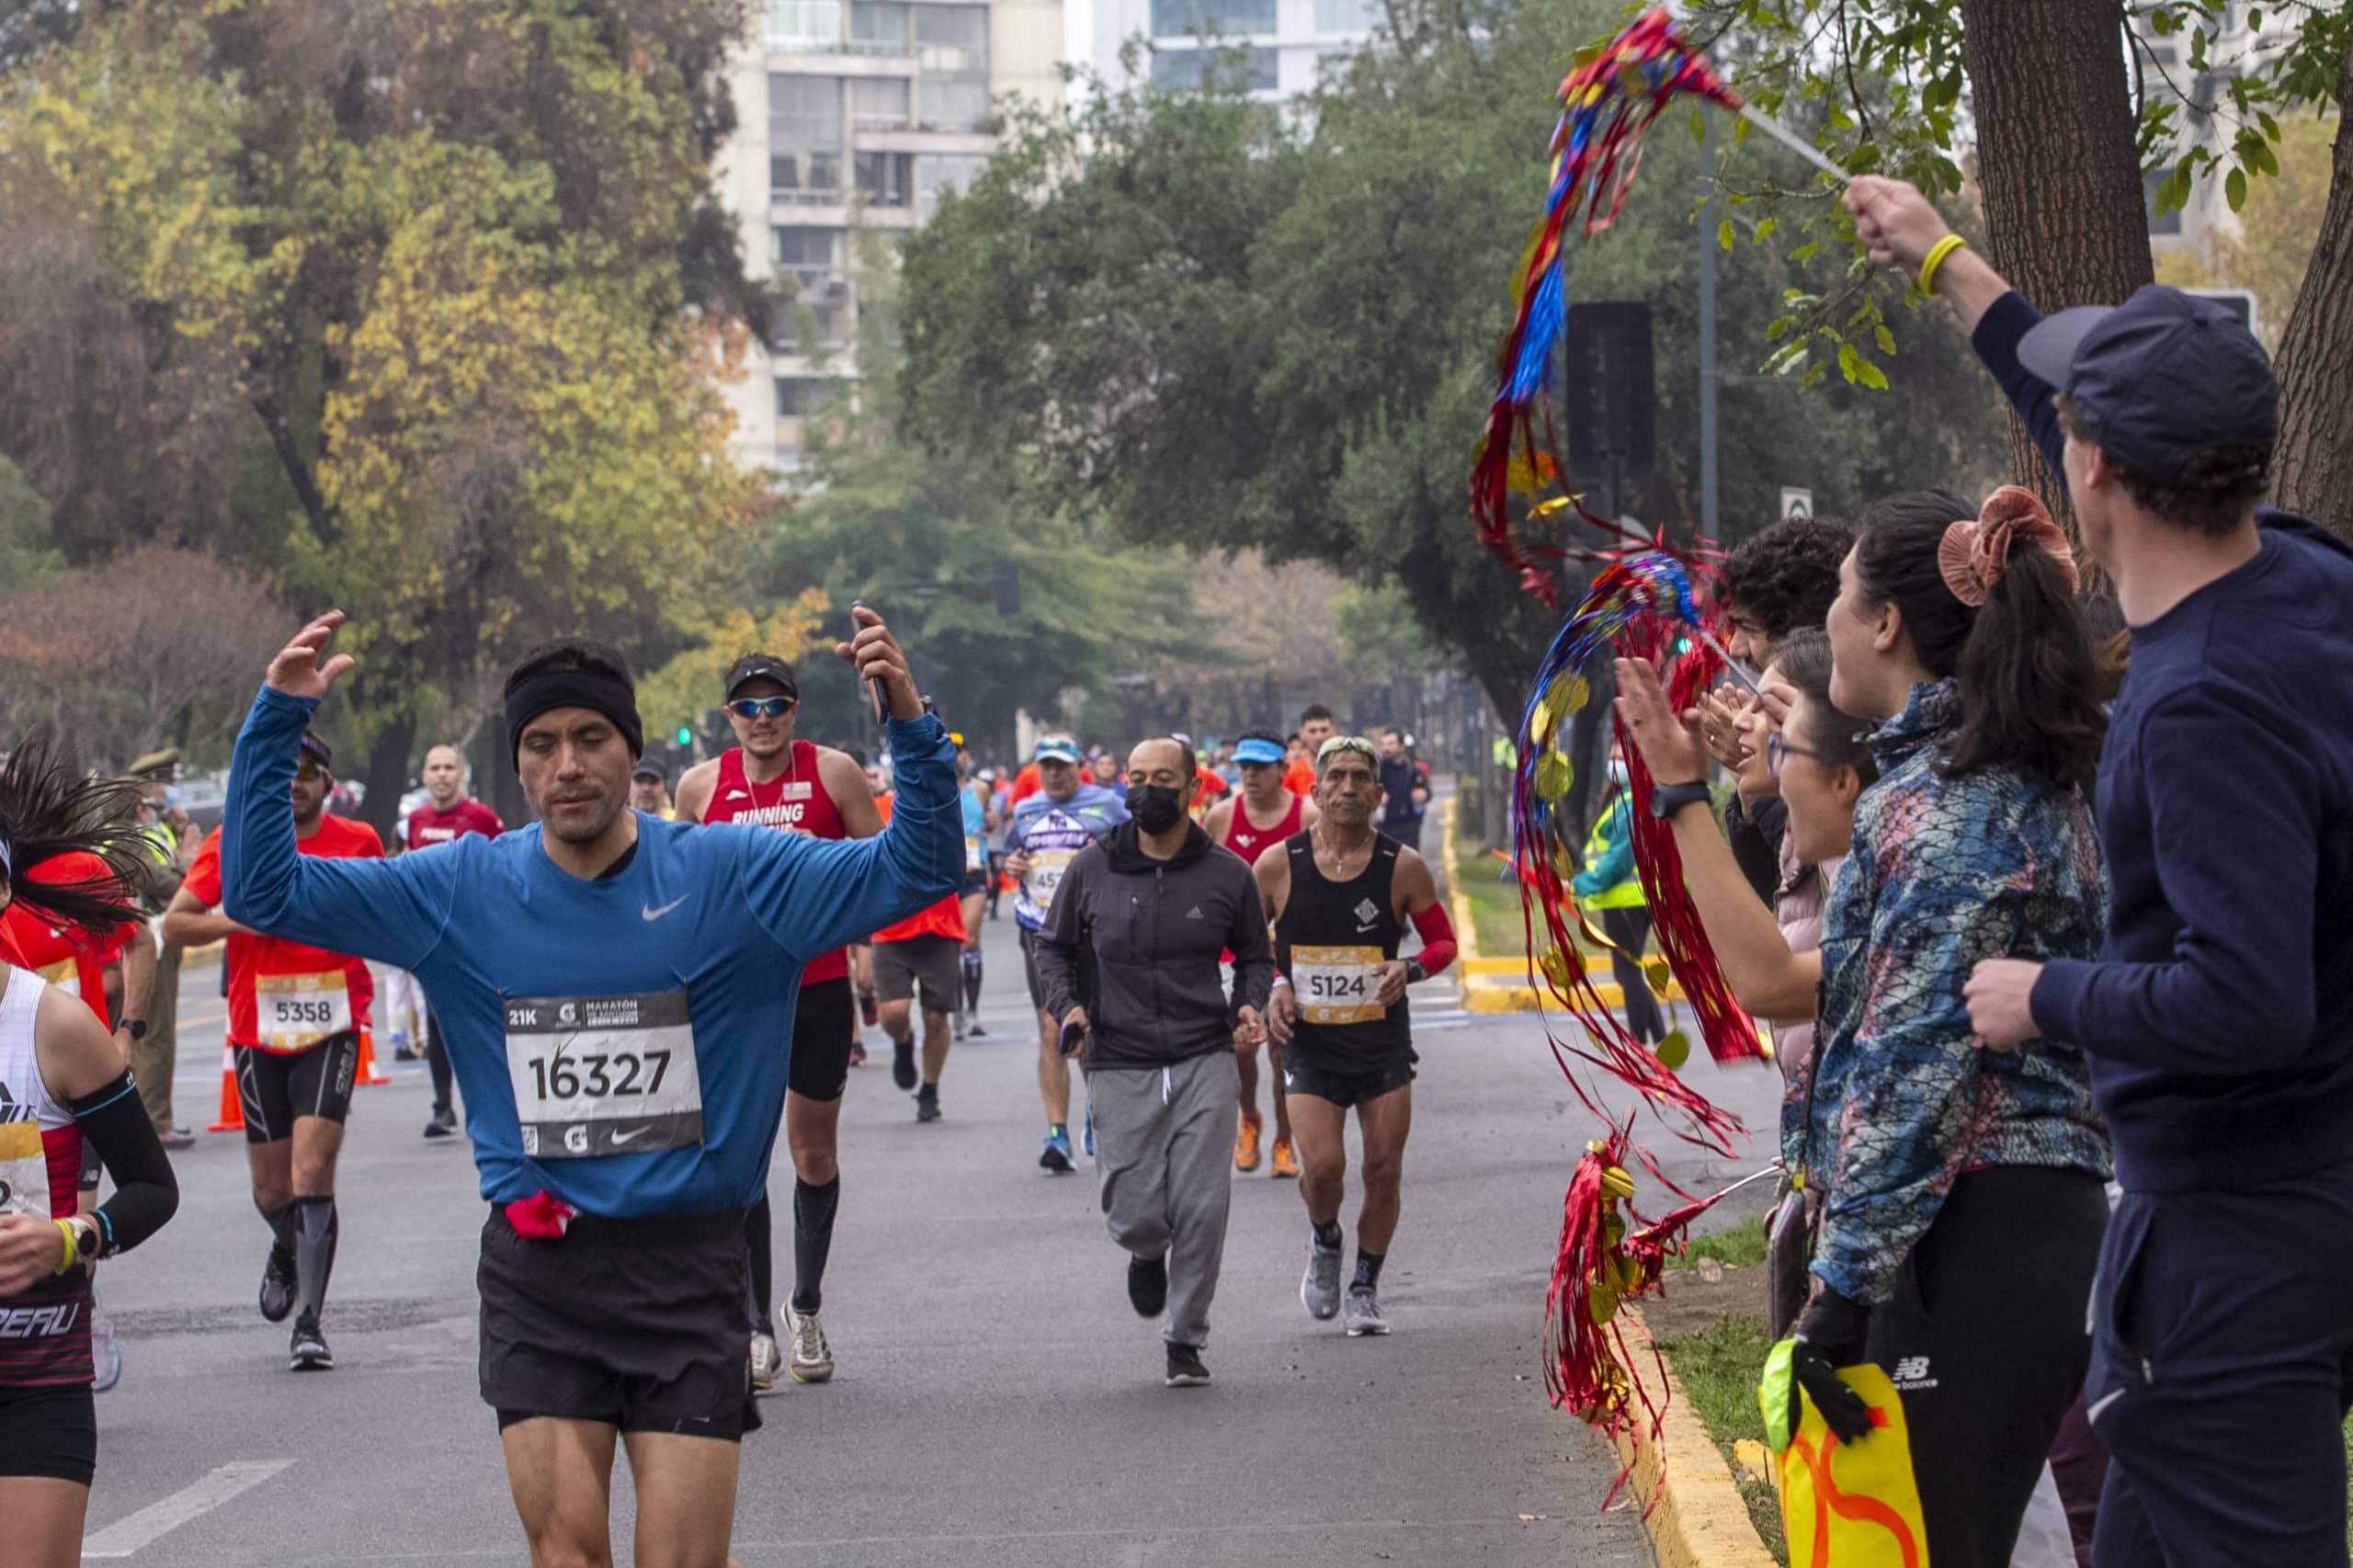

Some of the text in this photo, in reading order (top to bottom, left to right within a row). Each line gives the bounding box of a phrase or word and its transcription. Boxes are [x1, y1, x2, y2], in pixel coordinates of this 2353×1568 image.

[733, 803, 803, 824] RUNNING
[1036, 870, 1063, 889] 45
[1311, 975, 1366, 997] 5124
[277, 1002, 332, 1022] 5358
[509, 1009, 538, 1026] 21K
[529, 1049, 671, 1101] 16327
